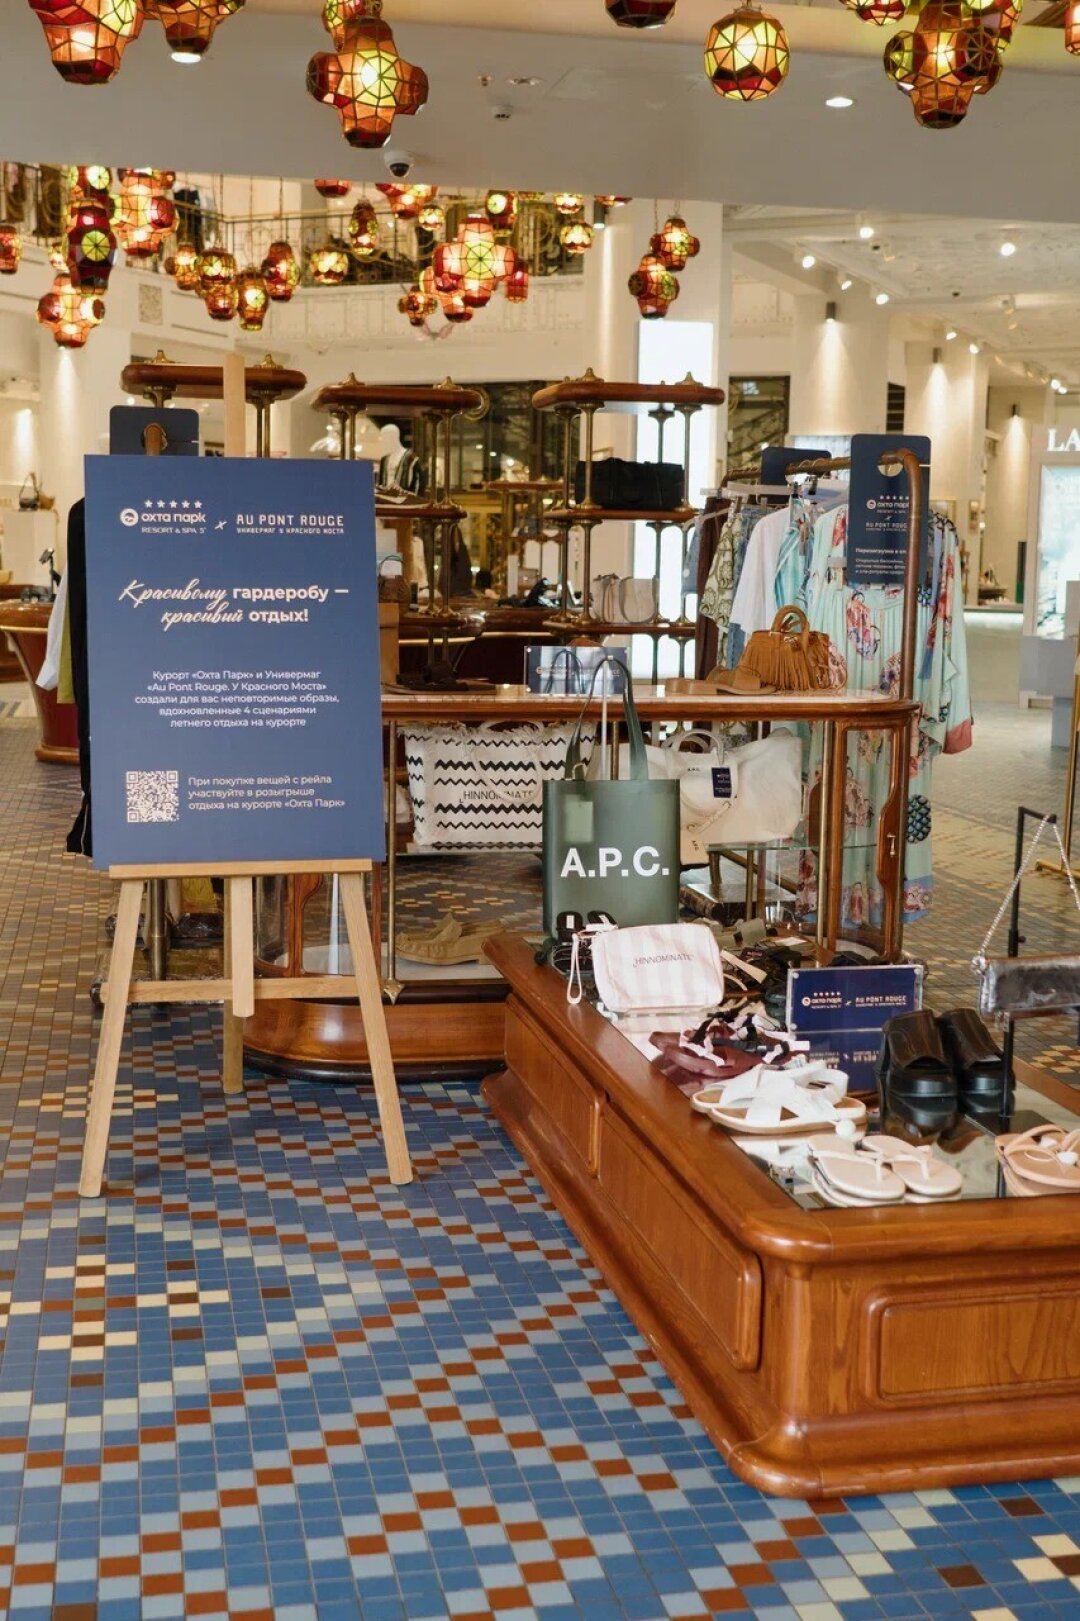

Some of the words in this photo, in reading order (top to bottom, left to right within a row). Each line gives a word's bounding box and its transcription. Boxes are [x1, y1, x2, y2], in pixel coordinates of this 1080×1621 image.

[236, 514, 254, 526] AU
[258, 514, 294, 526] PONT
[300, 515, 344, 527] ROUGE
[118, 578, 227, 610] Красивому
[232, 585, 329, 602] гардеробу
[248, 608, 309, 624] отдых!
[152, 670, 190, 681] Курорт
[191, 670, 221, 680] «Охта
[222, 670, 254, 681] Парк»
[265, 670, 321, 680] Универмаг
[147, 683, 166, 692] «Au
[168, 683, 193, 692] Pont
[195, 683, 230, 694] Rouge.
[241, 682, 290, 693] Красного
[291, 681, 328, 691] Моста»
[134, 695, 178, 705] создали
[179, 695, 200, 705] для
[201, 695, 219, 704] вас
[221, 694, 298, 705] неповторимые
[299, 693, 340, 704] образы,
[159, 707, 242, 717] вдохновленные
[243, 707, 251, 715] 4
[252, 707, 317, 716] сценариями
[170, 719, 211, 728] летнего
[213, 719, 249, 728] отдыха
[251, 719, 264, 727] на
[265, 718, 307, 729] курорте
[188, 776, 210, 786] При
[212, 776, 255, 787] покупке
[256, 775, 291, 785] вещей
[300, 774, 333, 785] рейла
[188, 788, 245, 799] участвуйте
[246, 789, 253, 797] в
[255, 788, 315, 797] розыгрыше
[188, 801, 225, 810] отдыха
[226, 801, 240, 809] на
[241, 800, 283, 810] курорте
[284, 799, 314, 808] «Охта
[315, 798, 346, 809] Парк»
[560, 846, 670, 877] A.P.C.
